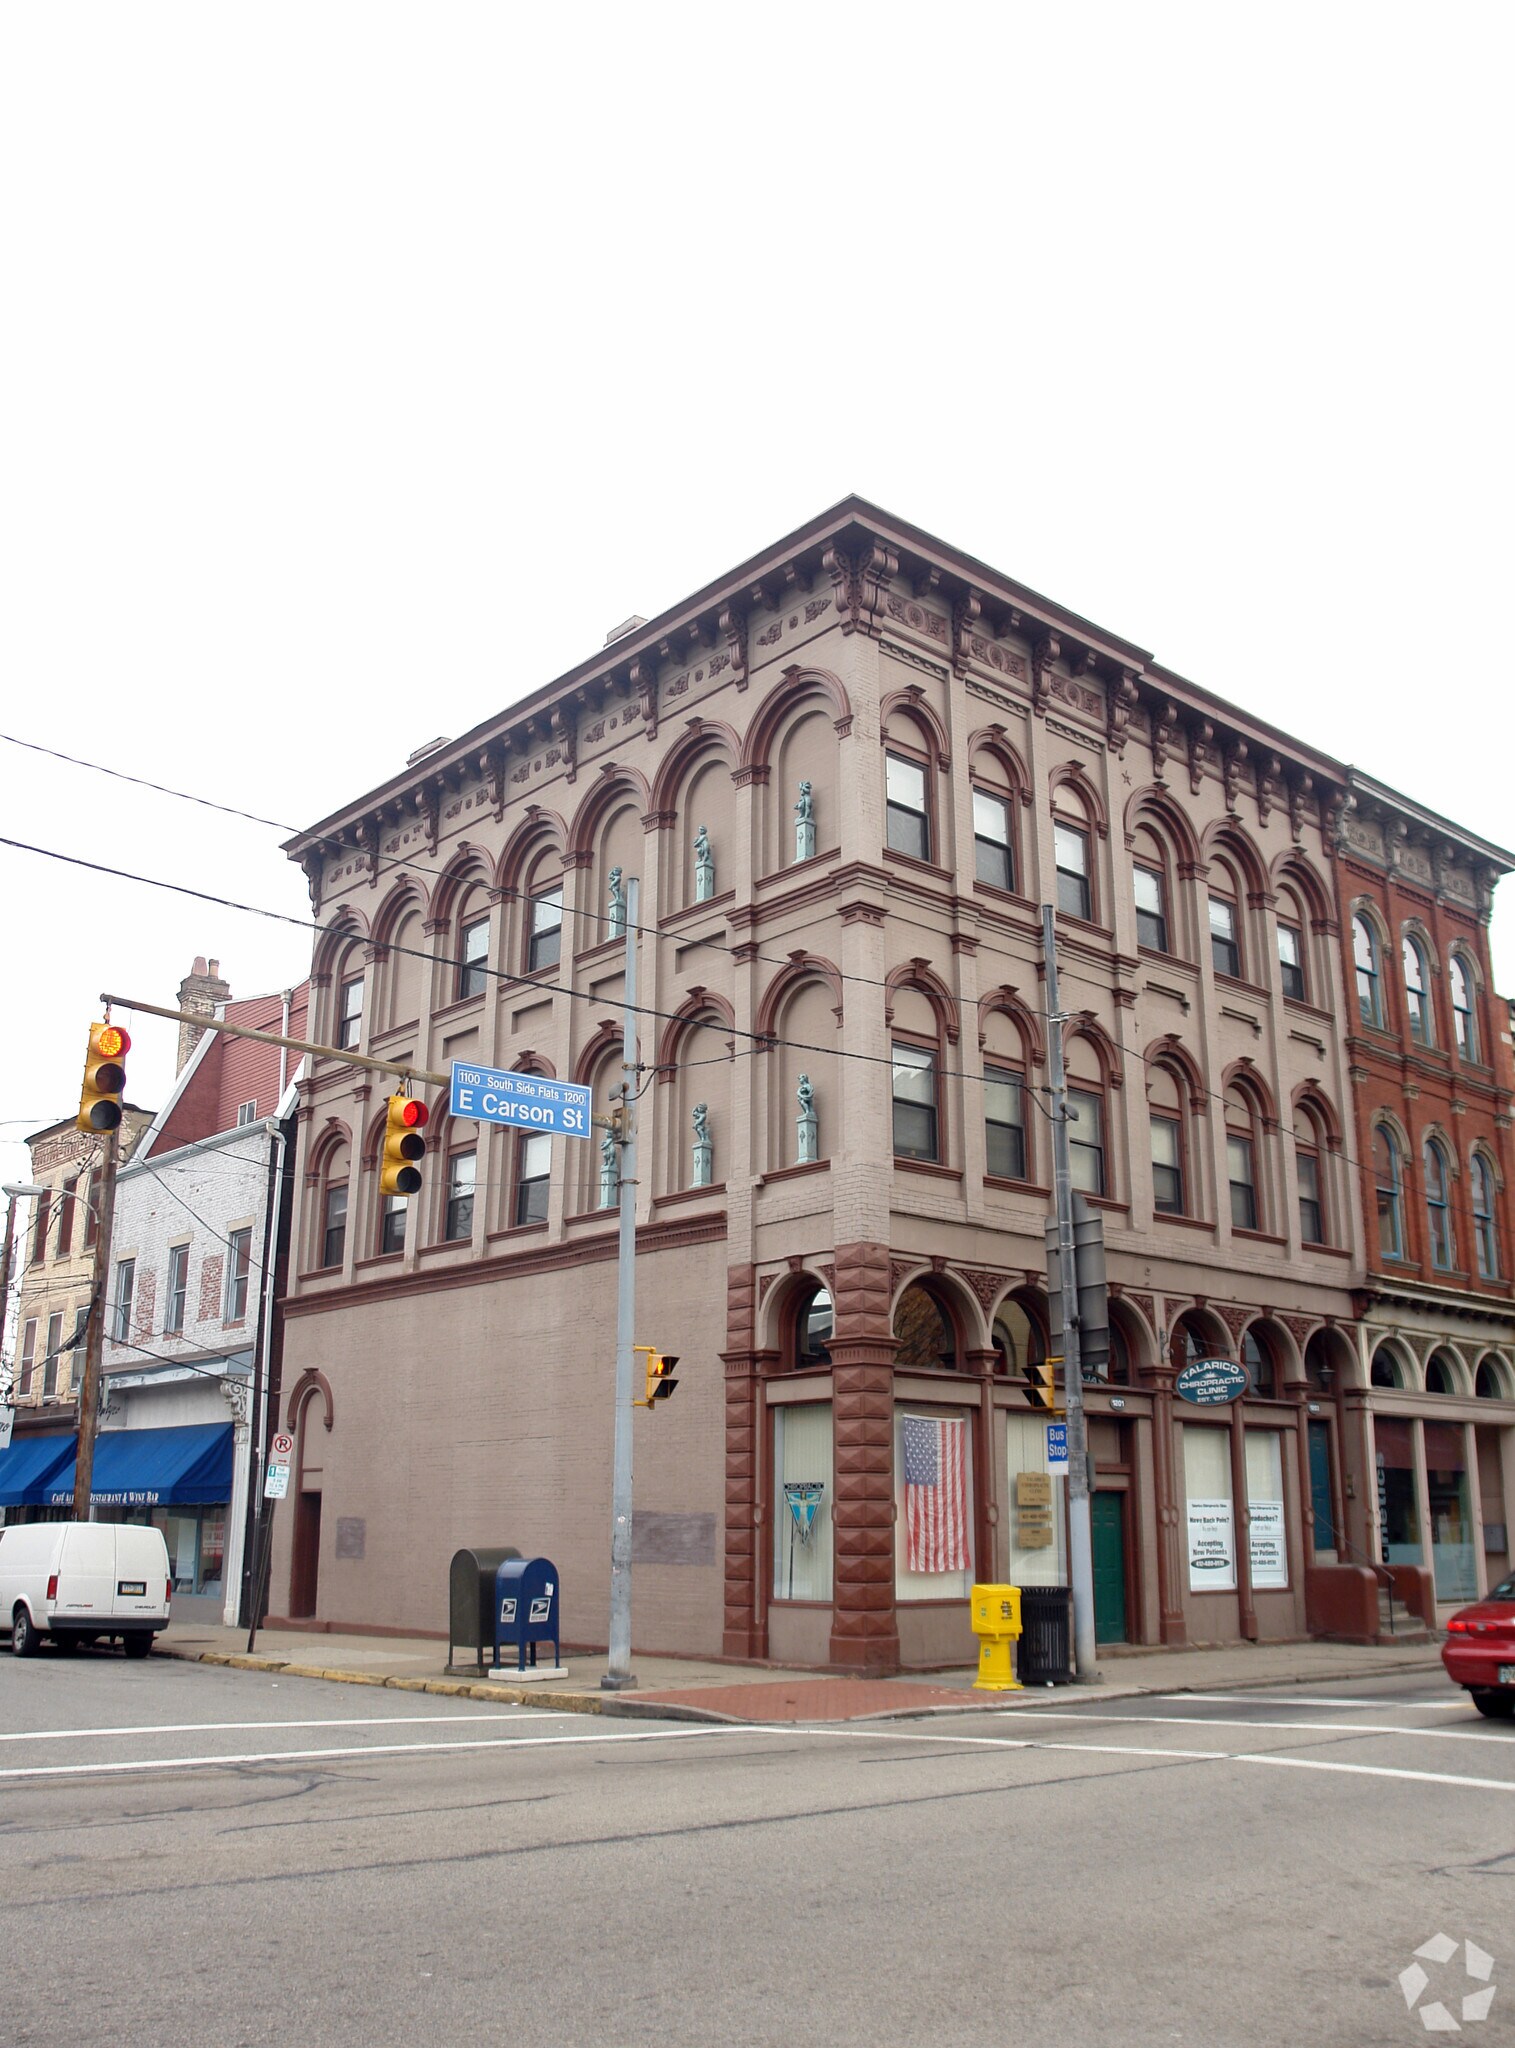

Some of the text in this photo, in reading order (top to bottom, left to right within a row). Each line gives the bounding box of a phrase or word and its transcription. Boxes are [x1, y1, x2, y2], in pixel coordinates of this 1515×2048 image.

[460, 1071, 585, 1105] 1100 South Side Flats 1200
[459, 1088, 584, 1130] E Carson St
[1182, 1361, 1239, 1379] TALARICO
[1180, 1376, 1245, 1389] CHIROPRACTIC
[1197, 1386, 1227, 1395] CLINIC
[1049, 1429, 1064, 1441] Bus
[1049, 1444, 1067, 1458] Stop
[784, 1482, 824, 1490] CHIROPRACTIC
[147, 1491, 159, 1503] BAR
